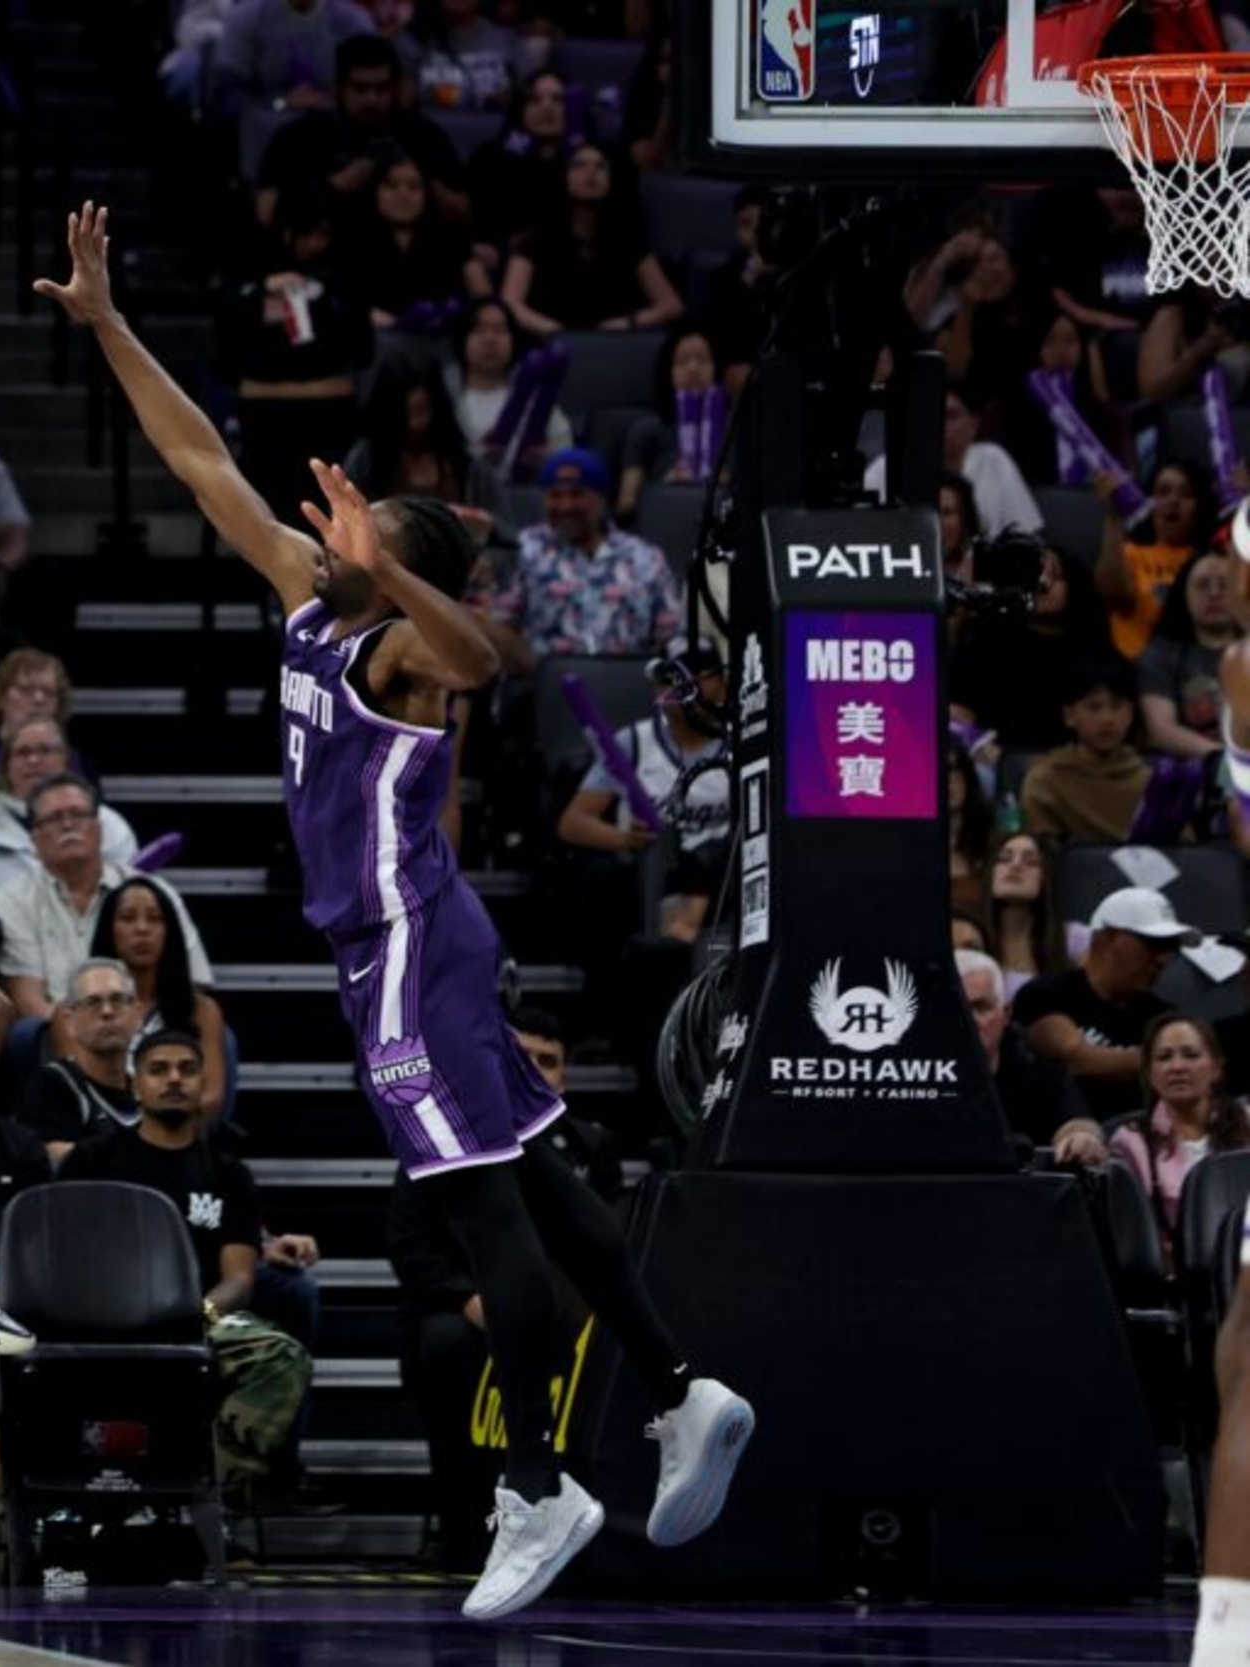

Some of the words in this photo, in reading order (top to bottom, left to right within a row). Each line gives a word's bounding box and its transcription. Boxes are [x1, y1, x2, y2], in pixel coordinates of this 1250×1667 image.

[765, 70, 793, 92] NBA
[787, 544, 932, 579] PATH.
[806, 639, 915, 683] MEBO
[370, 1057, 432, 1087] KINGS
[770, 1059, 958, 1083] REDHAWK
[792, 1087, 856, 1099] RESORT
[877, 1087, 939, 1100] CASINO
